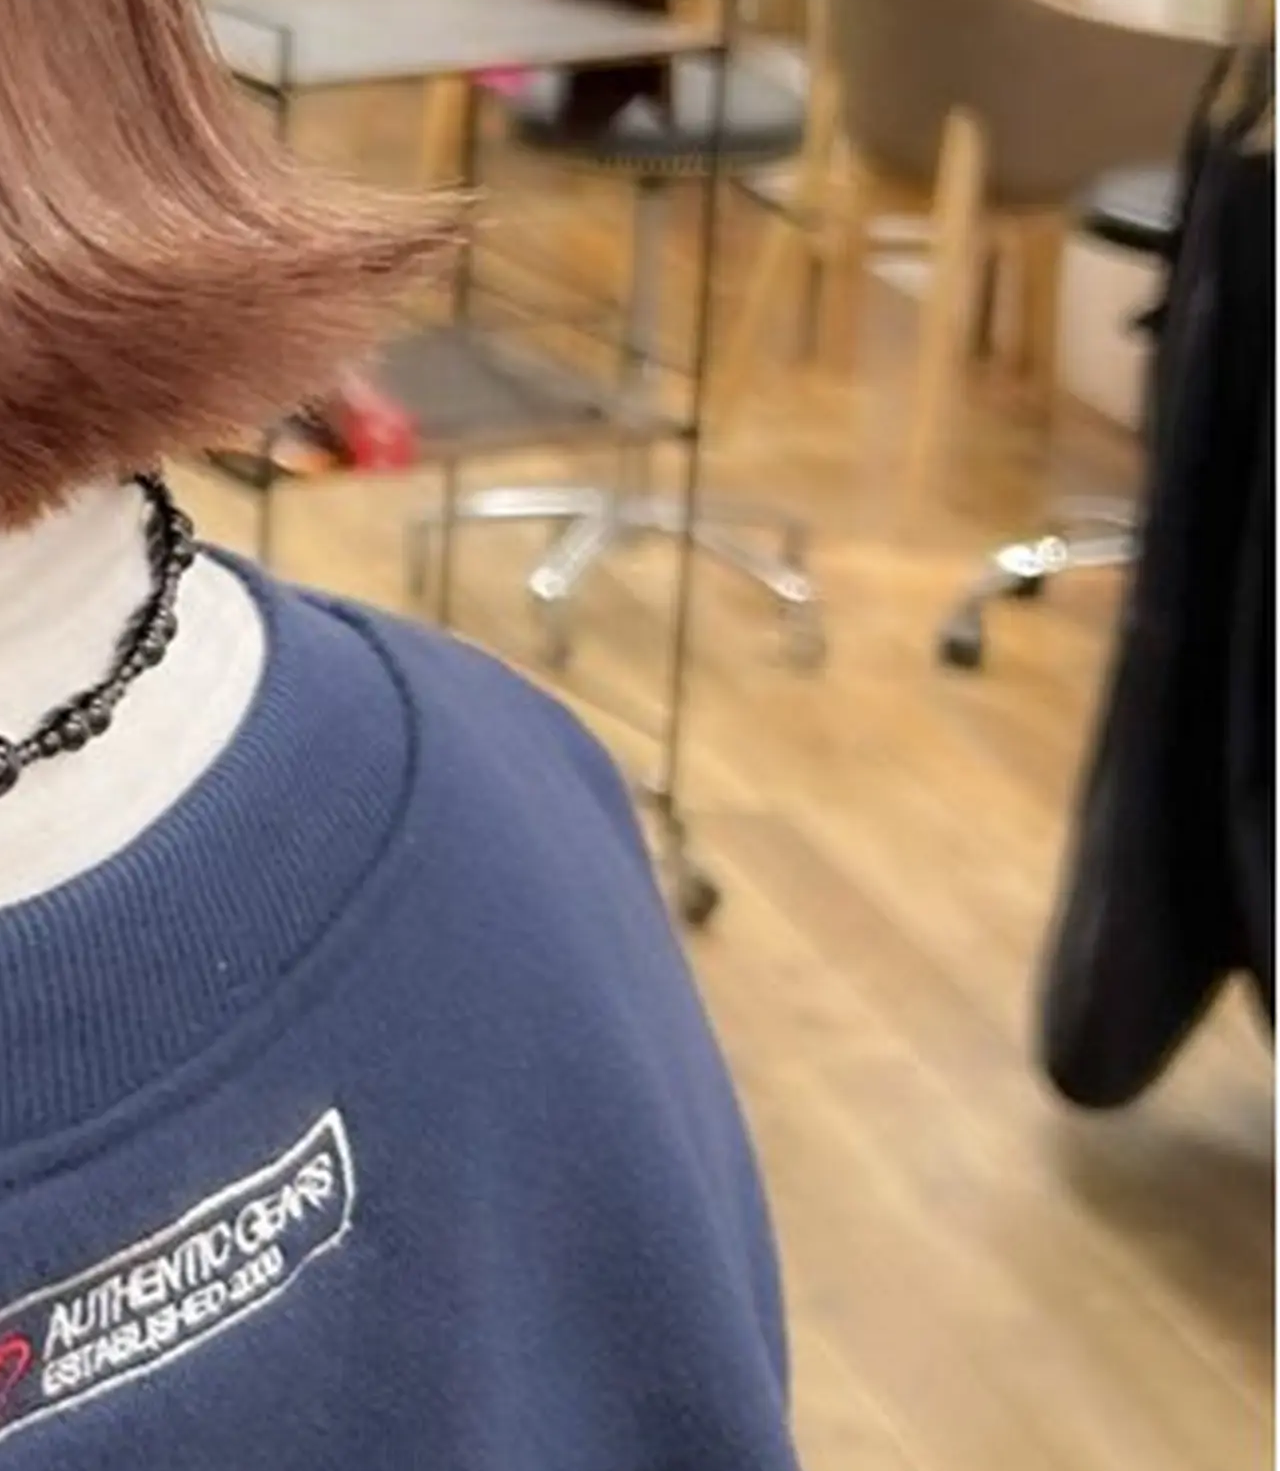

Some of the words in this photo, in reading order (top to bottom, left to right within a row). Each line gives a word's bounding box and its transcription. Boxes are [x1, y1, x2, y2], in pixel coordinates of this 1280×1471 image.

[42, 1222, 232, 1361] AUTHENTIC
[235, 1151, 334, 1253] GEARS
[41, 1281, 228, 1397] ESTABLISHED
